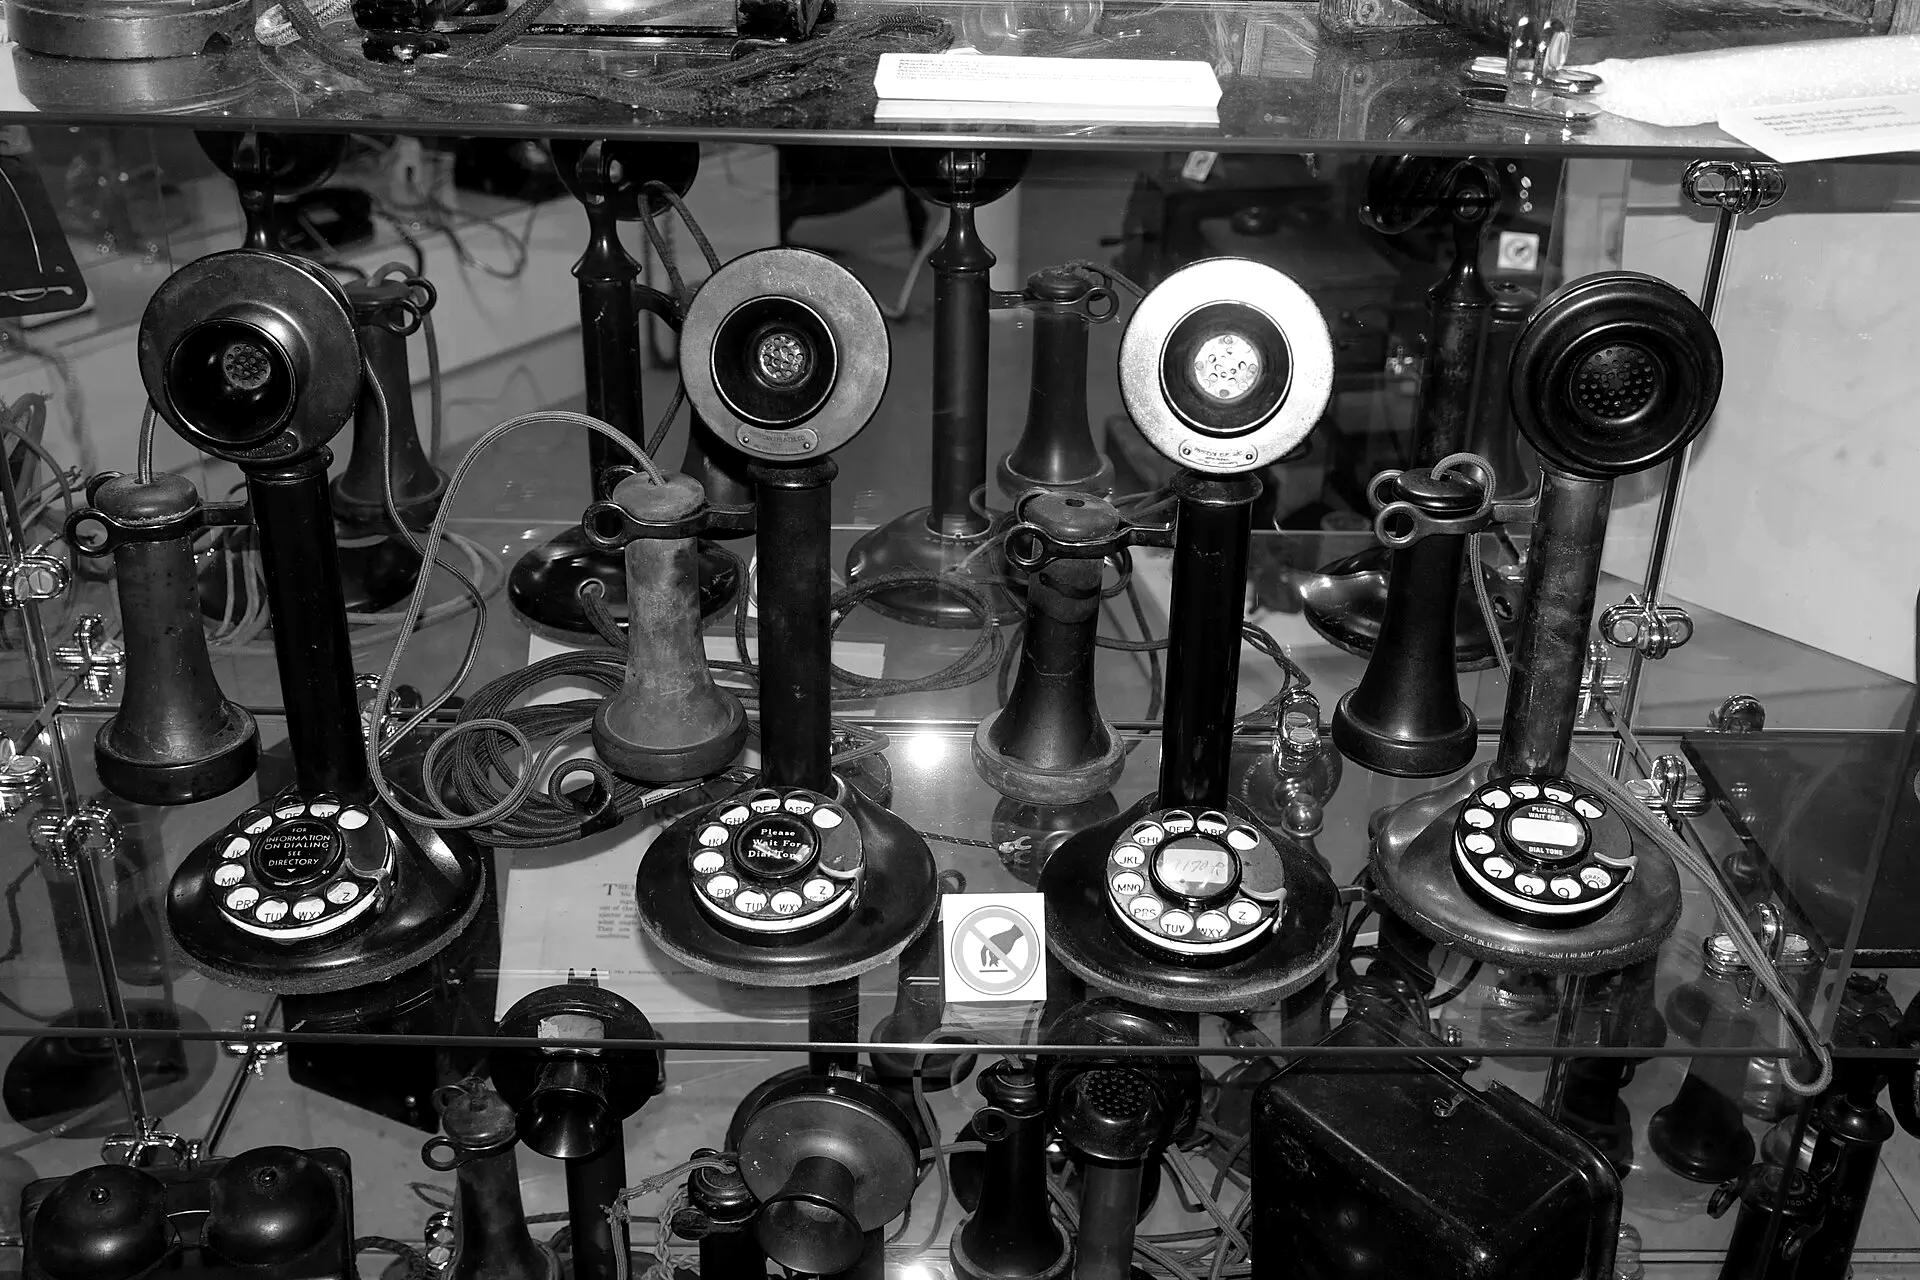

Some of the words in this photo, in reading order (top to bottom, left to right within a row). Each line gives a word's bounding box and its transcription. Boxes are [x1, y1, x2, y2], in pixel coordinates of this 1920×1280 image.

[1531, 806, 1556, 814] PLEASE
[1528, 812, 1545, 820] WAIT
[760, 828, 796, 837] Please
[265, 834, 331, 842] INFORMATION
[283, 841, 329, 850] DIALING
[753, 839, 778, 847] Wait
[783, 839, 801, 847] For
[748, 850, 771, 858] Dial
[778, 850, 803, 858] Tone
[1528, 846, 1544, 854] DIAL
[1545, 847, 1563, 855] TONE
[268, 858, 319, 866] DIRECTORY
[1119, 856, 1140, 865] JKL
[221, 876, 243, 886] MN
[820, 885, 826, 895] Z
[343, 892, 351, 900] Z
[1134, 907, 1156, 917] PRS
[1238, 911, 1246, 920] Z
[1165, 923, 1185, 933] TUV
[1198, 927, 1223, 937] WXY
